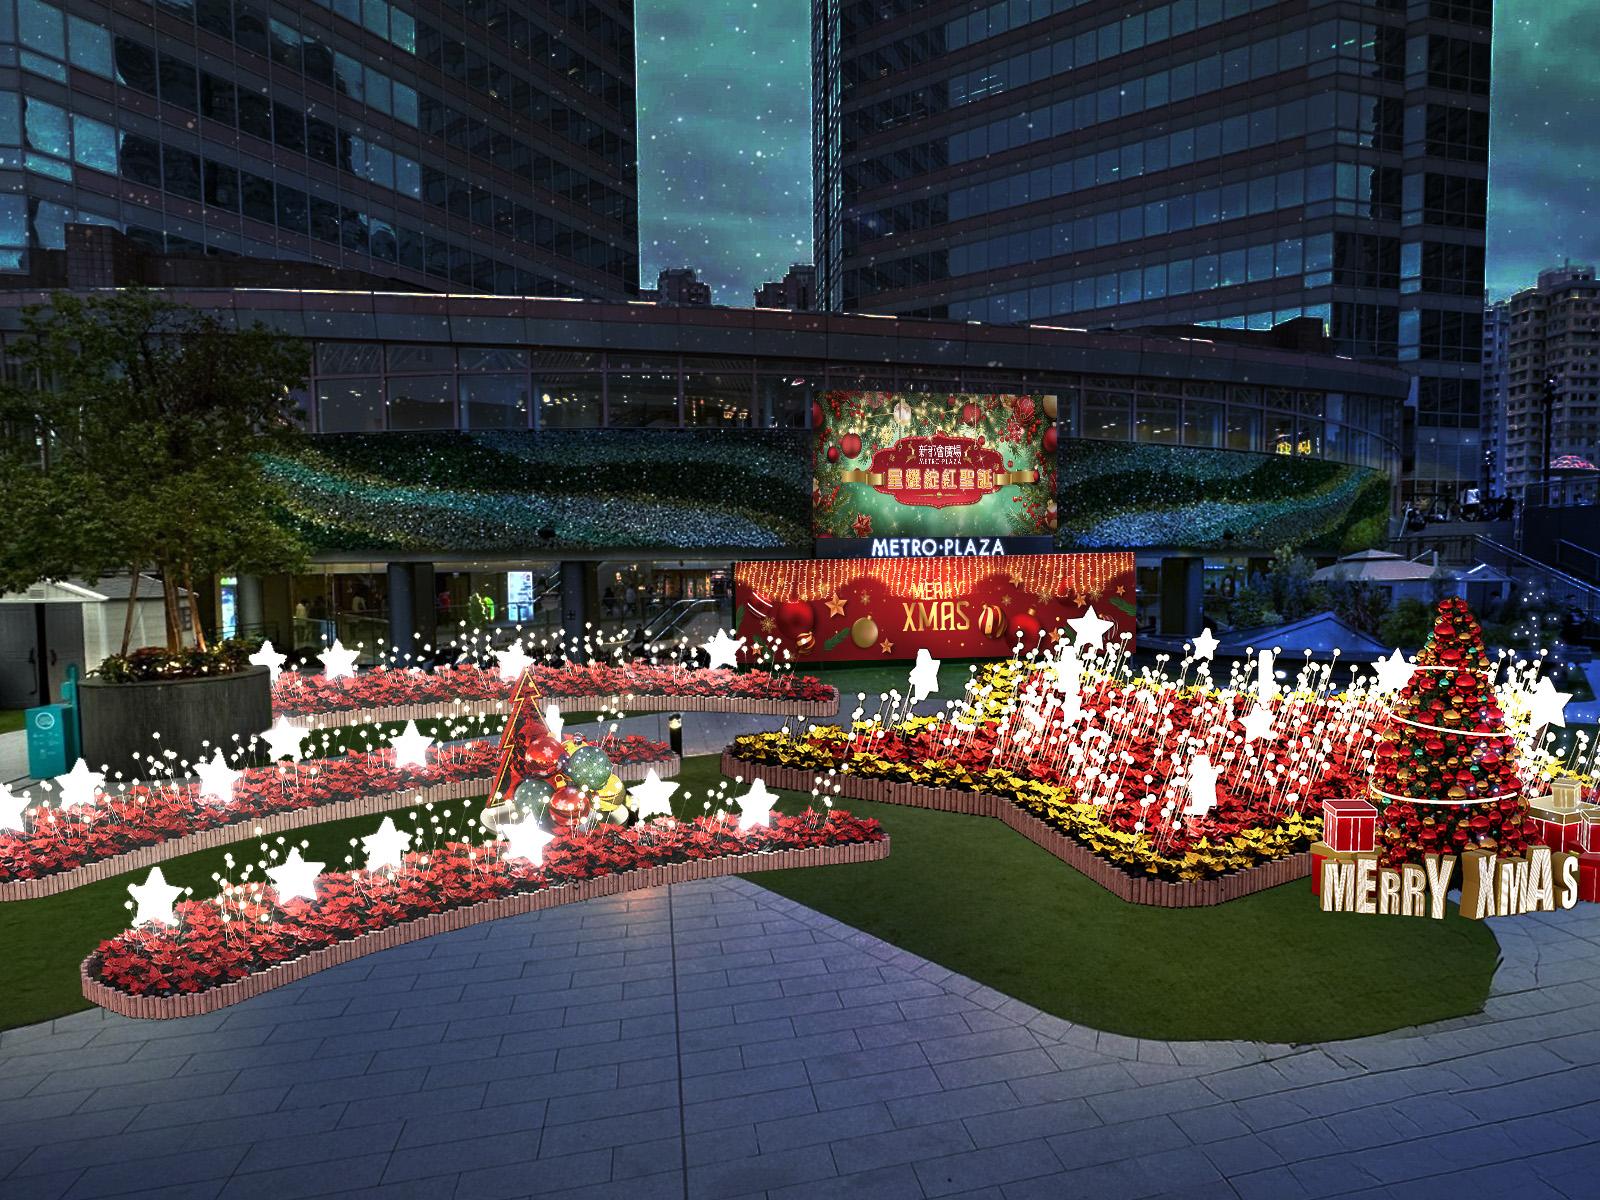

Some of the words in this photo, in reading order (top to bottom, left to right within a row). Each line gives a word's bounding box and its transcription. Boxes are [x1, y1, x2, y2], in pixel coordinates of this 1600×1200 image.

[912, 581, 966, 600] MERRY
[902, 601, 970, 631] XMAS
[1321, 853, 1457, 920] MERRY
[1472, 846, 1579, 920] XMAS
